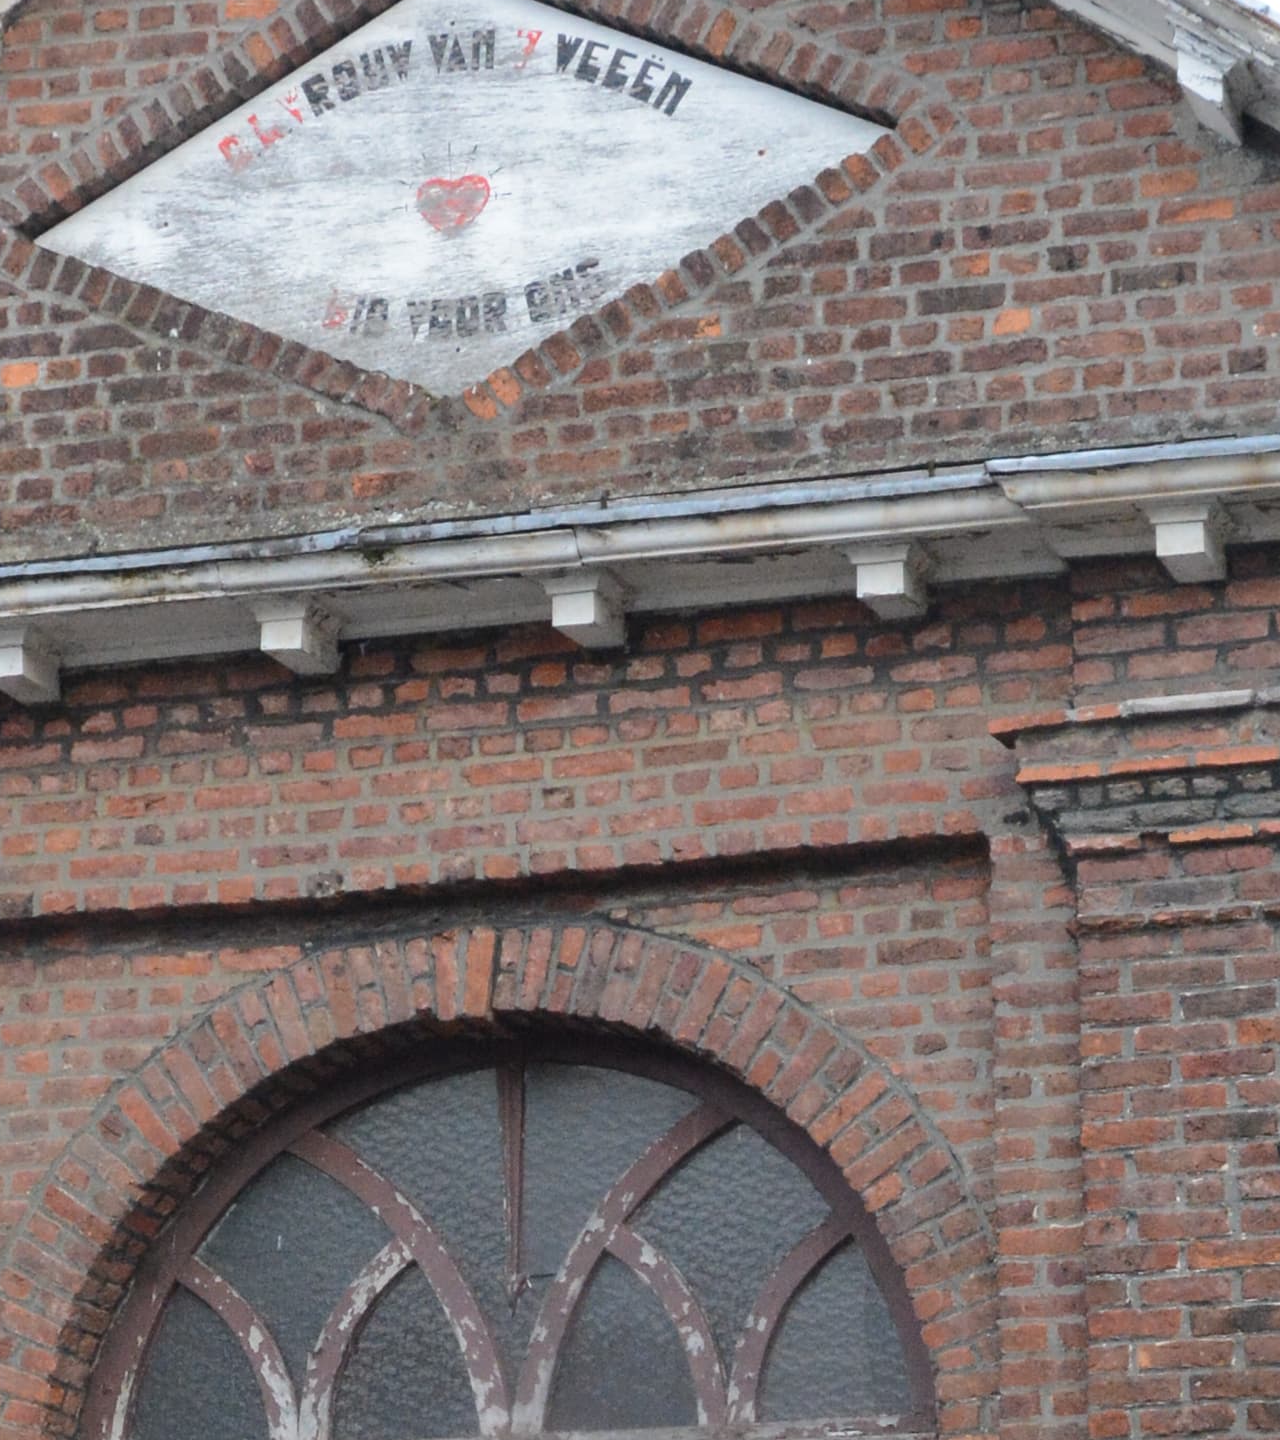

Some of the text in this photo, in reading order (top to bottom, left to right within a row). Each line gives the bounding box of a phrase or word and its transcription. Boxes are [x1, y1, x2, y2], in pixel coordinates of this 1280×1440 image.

[427, 28, 495, 74] VAN
[513, 29, 544, 70] 7
[556, 32, 693, 117] WEEËN
